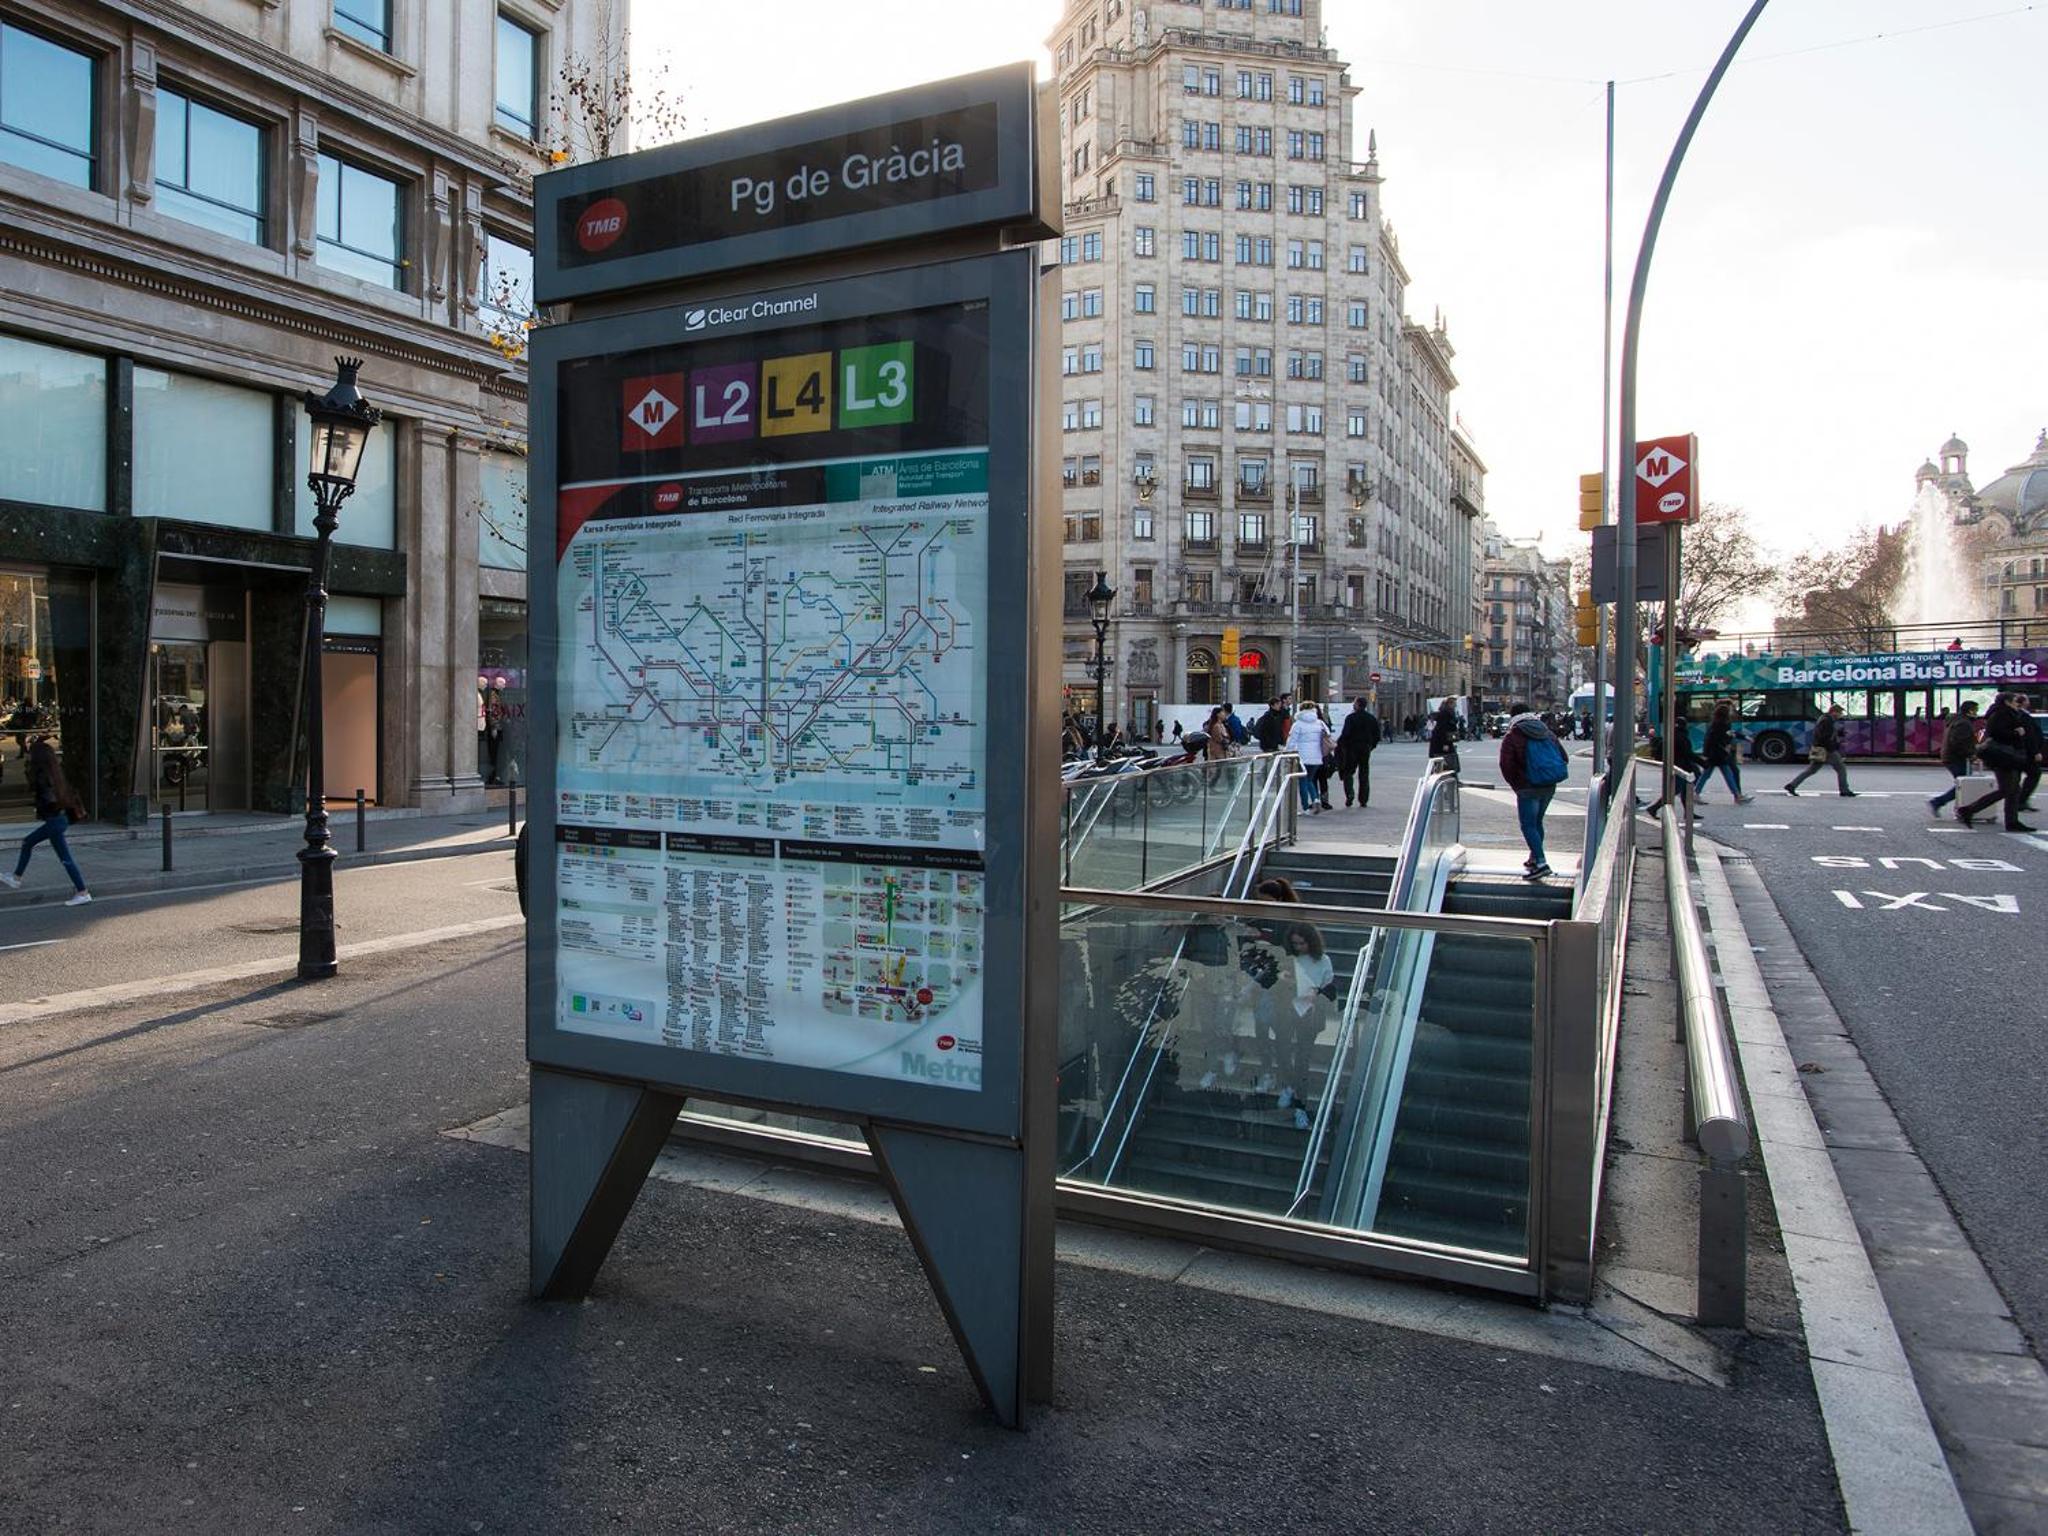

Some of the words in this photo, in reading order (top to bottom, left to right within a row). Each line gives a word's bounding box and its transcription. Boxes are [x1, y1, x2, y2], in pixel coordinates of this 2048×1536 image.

[731, 177, 775, 214] Pg
[786, 166, 831, 200] de
[842, 138, 965, 190] Gràcia
[586, 216, 621, 237] TMB
[707, 307, 749, 326] Clear
[751, 293, 818, 317] Channel
[643, 401, 664, 424] M
[695, 380, 750, 428] L2
[767, 371, 825, 419] L4
[846, 360, 908, 411] L3
[921, 461, 932, 472] de
[934, 459, 980, 472] Barcelona
[1646, 456, 1669, 477] M
[658, 492, 680, 503] TMB
[687, 498, 699, 506] de
[701, 494, 748, 505] Barcelona
[872, 502, 917, 513] Integrated
[918, 499, 951, 511] Railway
[954, 498, 989, 509] Networ
[1663, 499, 1682, 507] TMB
[728, 514, 744, 523] Red
[1835, 656, 1873, 665] ORIGINAL
[1880, 655, 1916, 663] OFFICIAL
[1919, 653, 1941, 661] TOUR
[1778, 665, 1897, 683] Barcelona
[1900, 659, 2038, 680] BusTurístic
[1810, 856, 2025, 872] BUS
[1831, 889, 2021, 913] AXI
[901, 1051, 981, 1085] Metro
